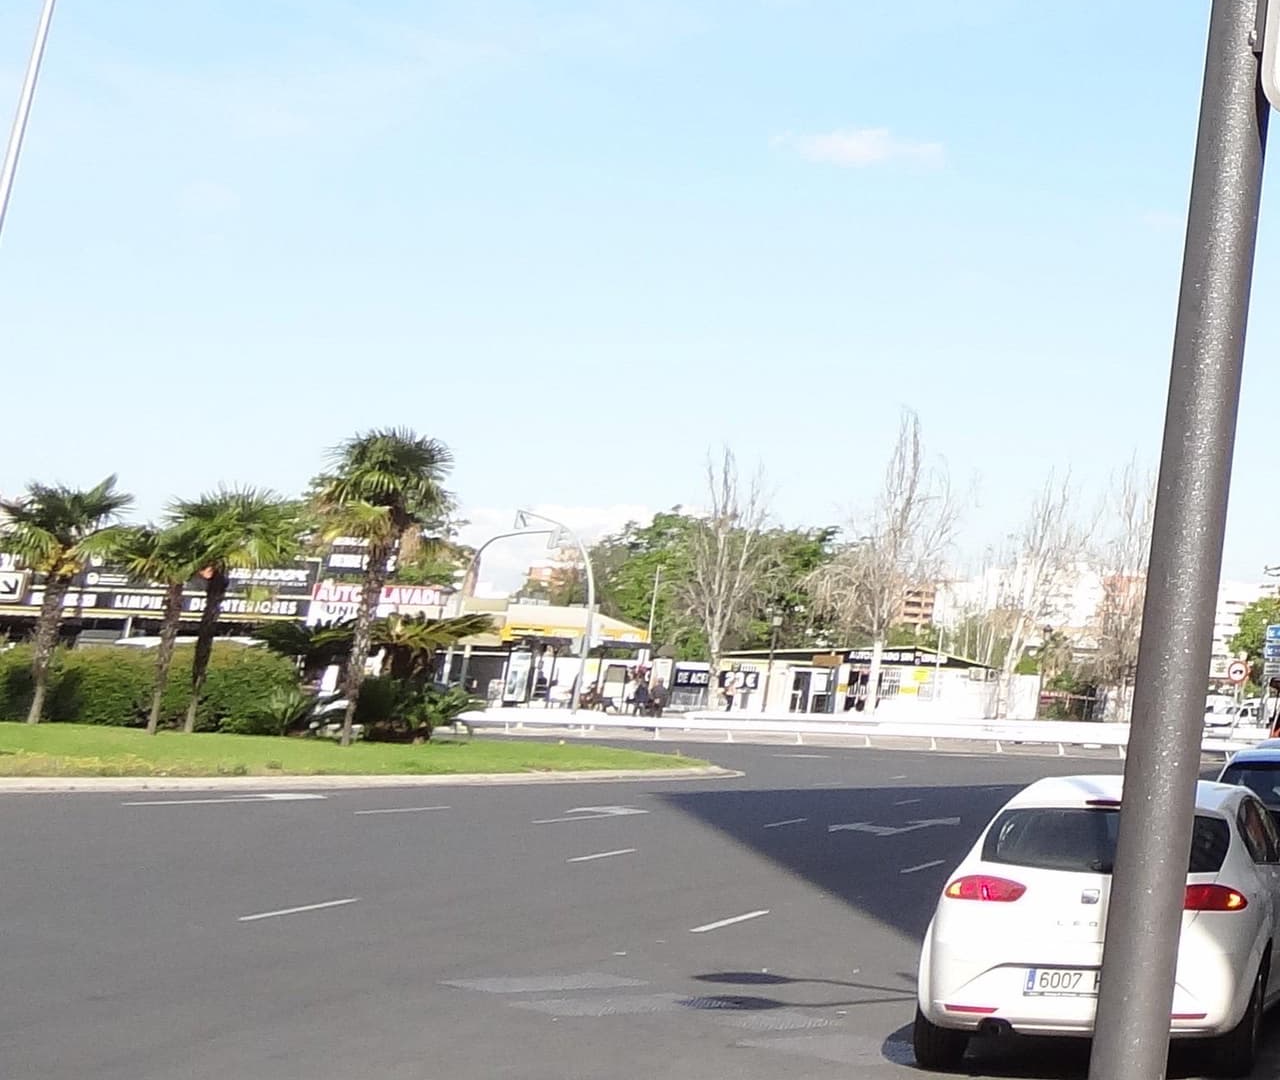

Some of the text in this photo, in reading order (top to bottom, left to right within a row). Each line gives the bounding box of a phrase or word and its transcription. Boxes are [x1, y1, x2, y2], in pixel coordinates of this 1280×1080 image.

[114, 594, 168, 610] LIMPIE
[219, 600, 297, 614] NTERIORES
[1039, 971, 1083, 989] 6007
